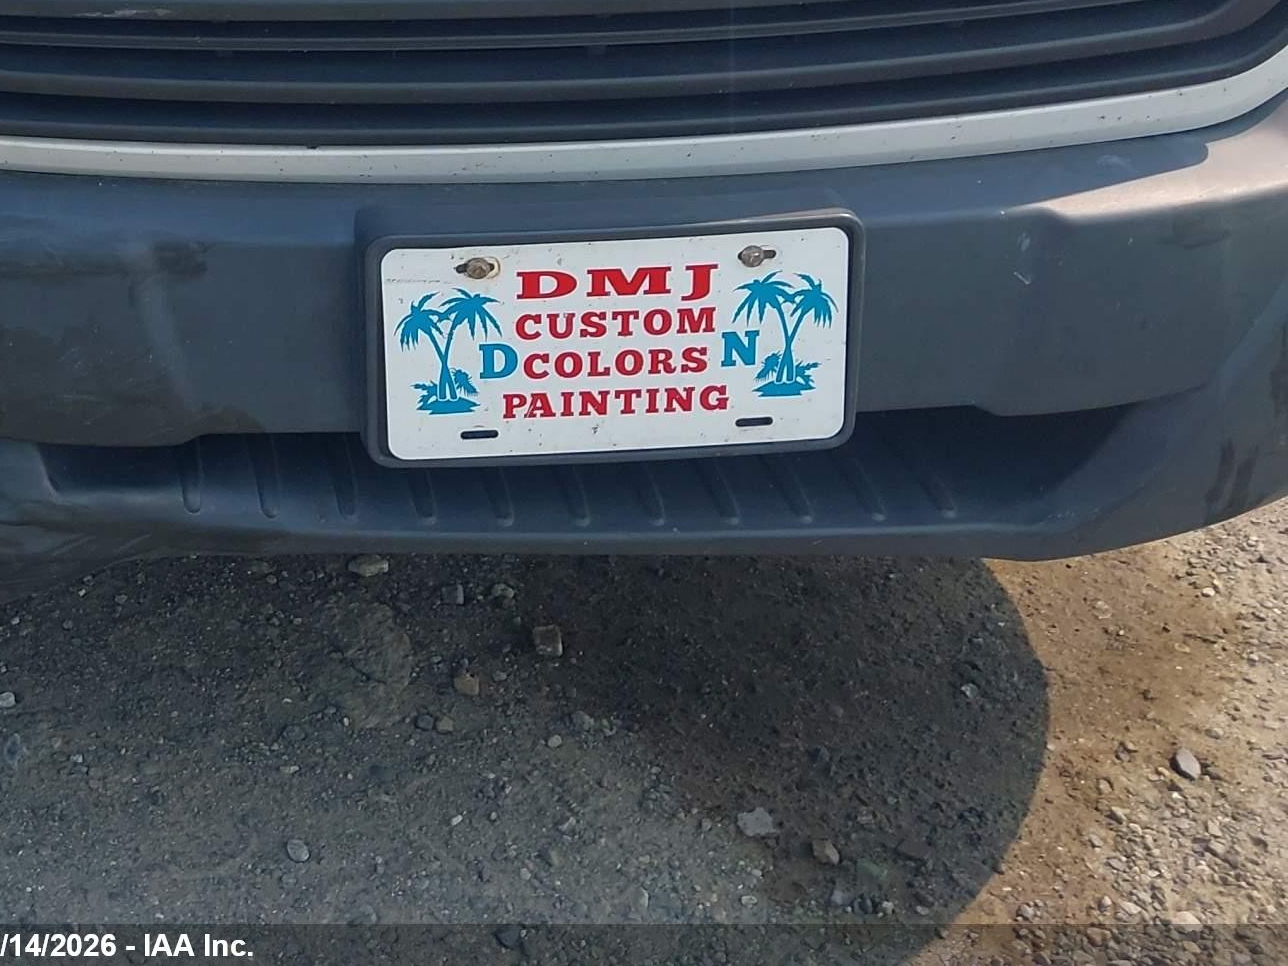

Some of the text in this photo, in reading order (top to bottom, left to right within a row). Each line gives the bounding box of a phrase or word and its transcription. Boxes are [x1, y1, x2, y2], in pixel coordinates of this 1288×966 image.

[516, 264, 719, 301] DMJ
[514, 306, 717, 341] CUSTOM
[478, 342, 519, 380] D
[522, 346, 709, 380] COLORS
[720, 329, 760, 368] N
[502, 384, 730, 420] PAINTING
